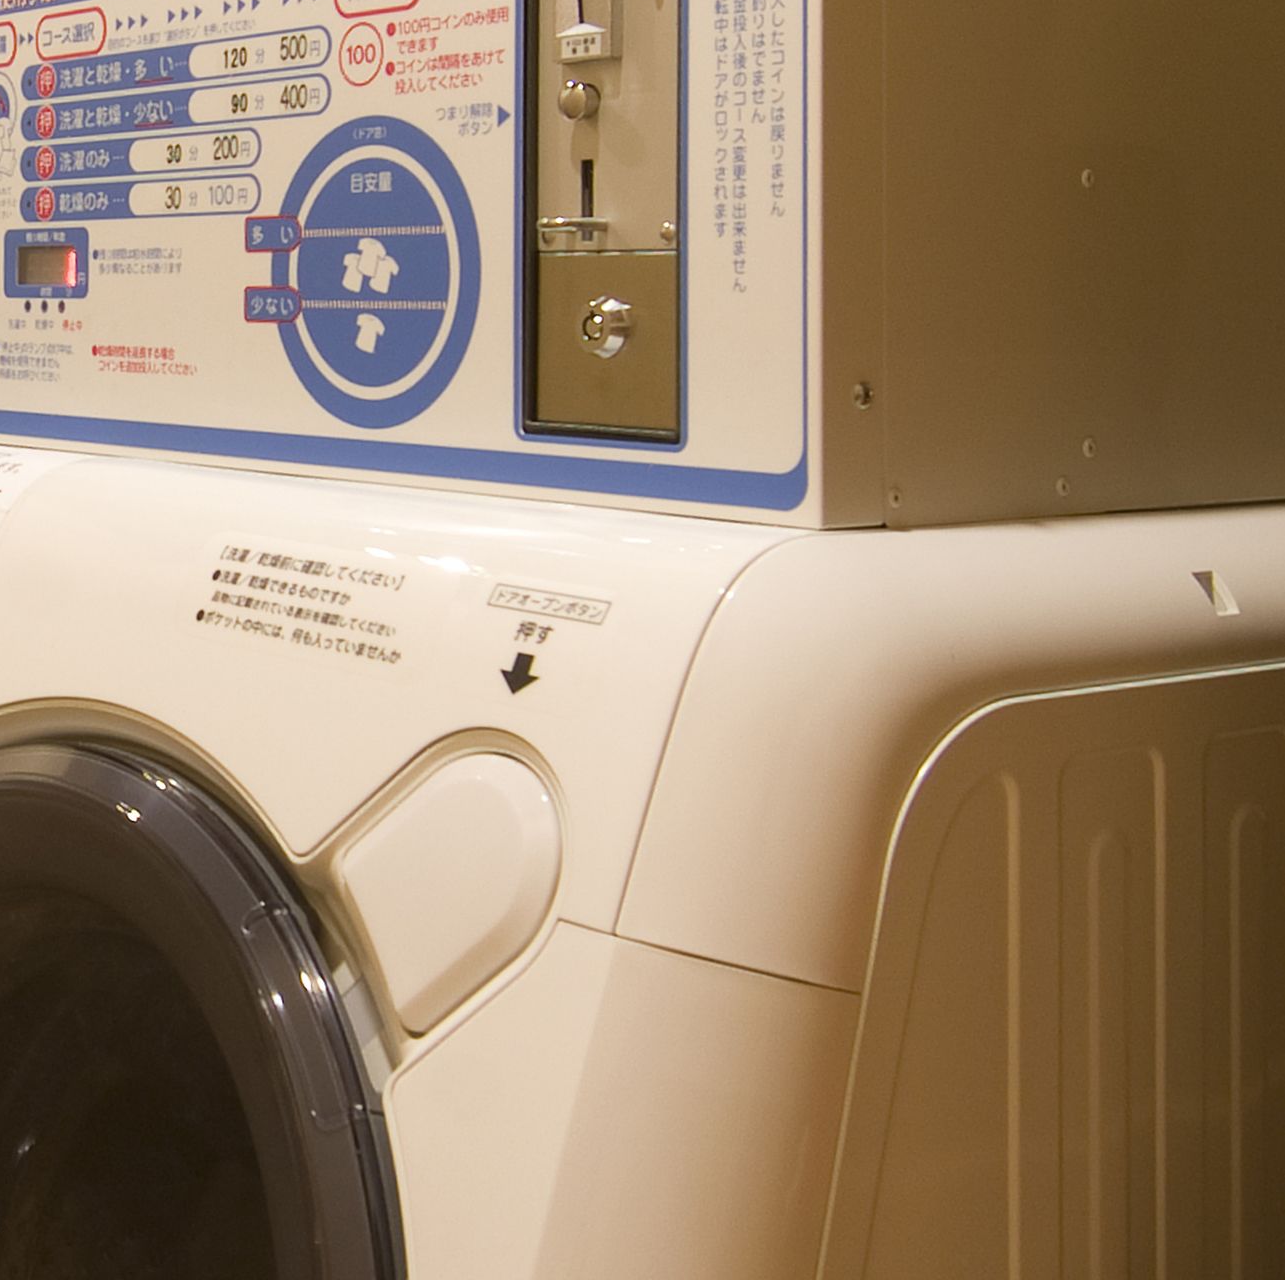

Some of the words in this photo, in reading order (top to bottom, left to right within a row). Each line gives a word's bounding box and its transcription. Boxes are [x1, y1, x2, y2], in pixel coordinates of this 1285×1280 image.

[398, 7, 509, 35] 100円コインのみ使用
[41, 21, 96, 48] コース選択
[346, 43, 376, 65] 100
[396, 37, 438, 55] できます
[223, 48, 248, 68] 120
[395, 73, 483, 95] 投入してください
[230, 92, 249, 113] 90
[458, 121, 493, 137] ボタン
[166, 143, 182, 164] 30
[350, 171, 393, 193] 目安量
[165, 187, 182, 209] 30
[250, 295, 294, 315] 少ない
[493, 587, 605, 621] ドアオープンボタン
[514, 621, 555, 645] 押す
